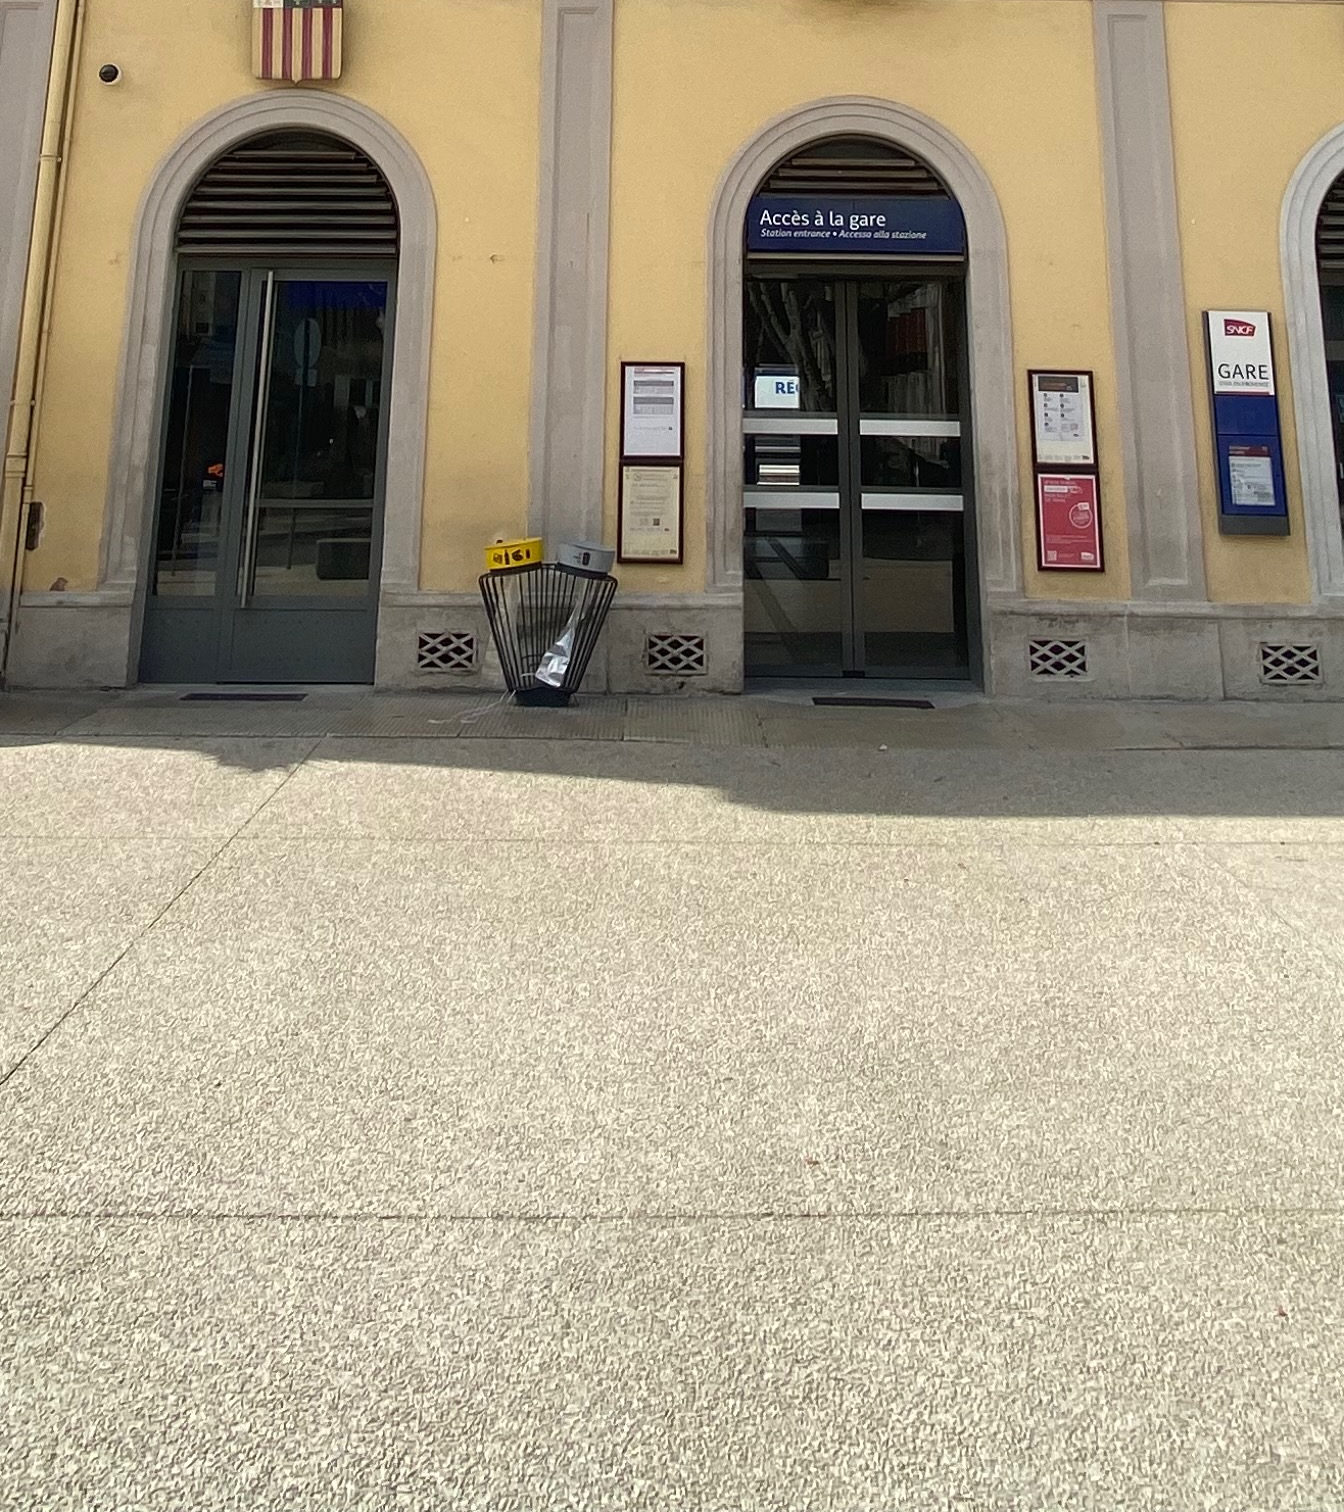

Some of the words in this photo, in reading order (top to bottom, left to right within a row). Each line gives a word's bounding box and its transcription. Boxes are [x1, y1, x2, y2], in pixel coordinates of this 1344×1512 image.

[760, 209, 810, 226] Accès
[814, 210, 824, 226] à
[829, 211, 844, 227] la
[849, 213, 887, 231] gare
[760, 228, 792, 238] Station
[793, 230, 831, 238] entrance
[838, 229, 872, 239] Accesso
[873, 230, 890, 239] alla
[891, 230, 927, 240] stazione
[1226, 324, 1254, 335] SNCF
[1217, 363, 1269, 381] GARE
